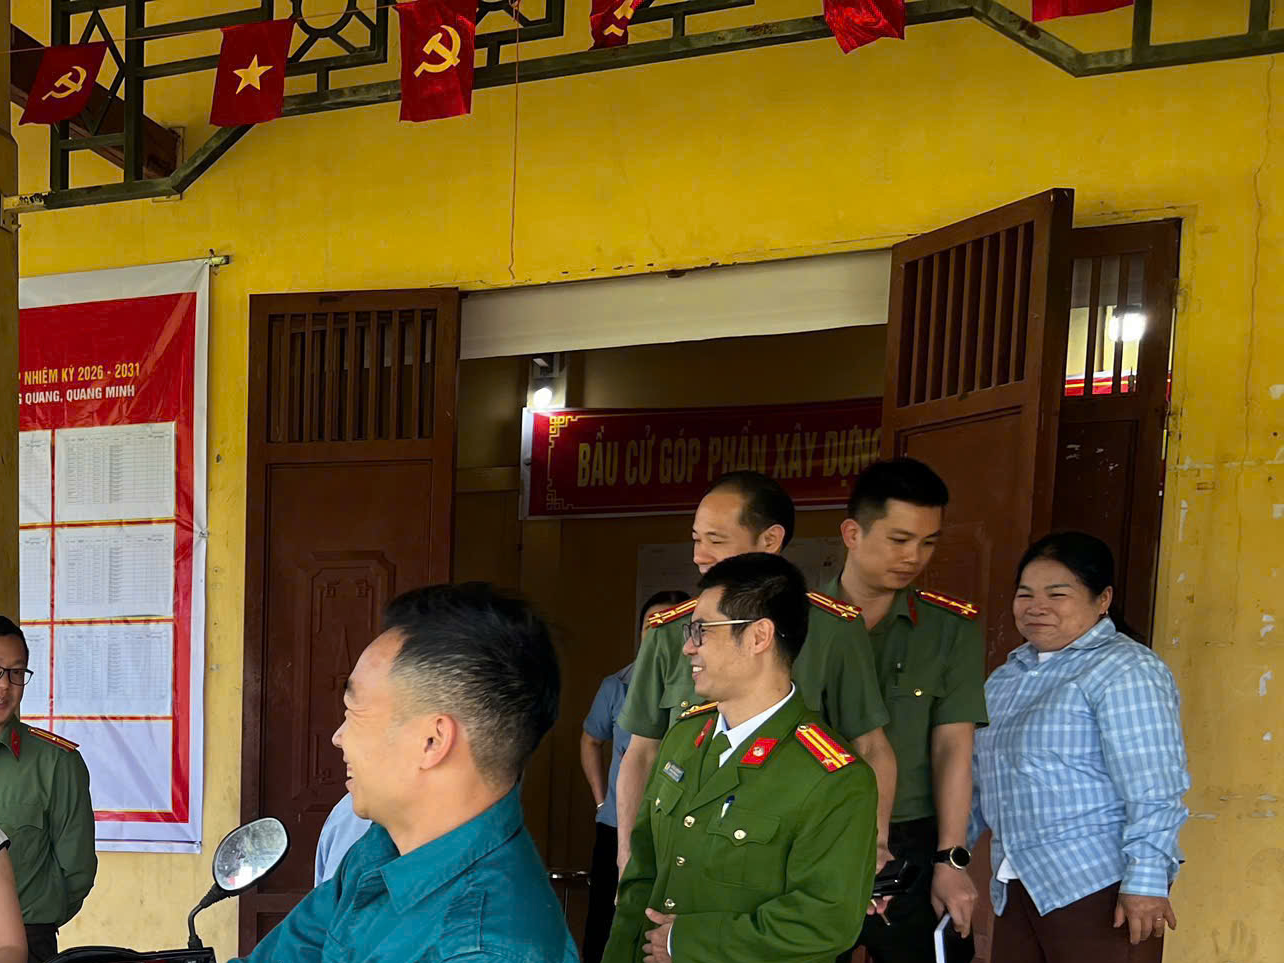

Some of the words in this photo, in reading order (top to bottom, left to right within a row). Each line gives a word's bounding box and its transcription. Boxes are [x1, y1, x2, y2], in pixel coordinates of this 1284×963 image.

[24, 366, 58, 387] NHIỆM
[77, 365, 104, 381] 2026
[115, 362, 140, 378] 2031
[25, 390, 63, 405] QUANG,
[67, 386, 102, 402] QUANG
[105, 384, 135, 398] MINH
[624, 424, 656, 486] CỬ
[659, 427, 701, 484] GÓP
[773, 423, 818, 479] XÂY
